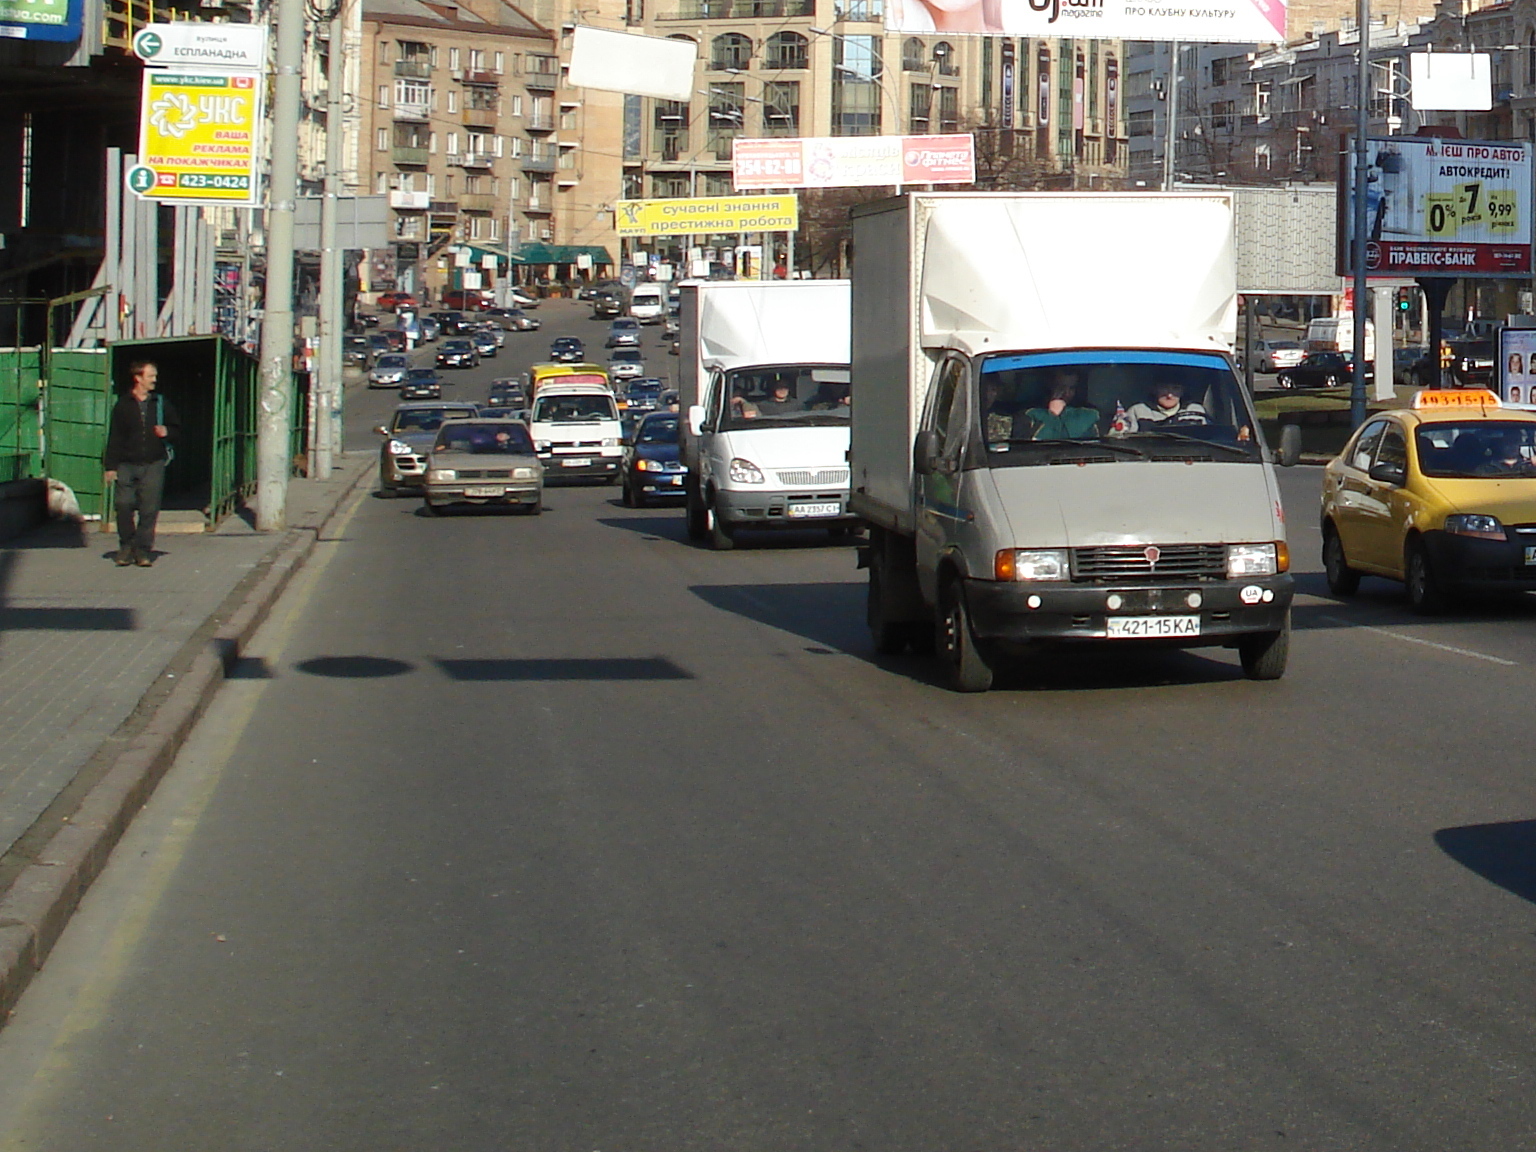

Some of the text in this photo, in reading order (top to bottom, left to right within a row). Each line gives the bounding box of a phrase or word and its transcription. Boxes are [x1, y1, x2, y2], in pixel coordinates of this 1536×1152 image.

[1125, 7, 1236, 19] ПРО КЛУБНУ КУЛЬТУРУ
[174, 47, 248, 59] ЕСПЛАНАДНА
[198, 95, 246, 124] УКС
[215, 131, 249, 139] ВАША
[193, 144, 250, 154] РЕКЛАМА
[1467, 147, 1489, 159] ПРО
[148, 156, 249, 167] НА ПОКАЖЧИКАХ
[1439, 166, 1510, 179] АВТОКРЕДИТ!
[181, 175, 248, 188] 423-0424
[1464, 184, 1480, 214] 7
[662, 201, 780, 216] сучасні знання
[651, 215, 793, 232] престижна робота
[1389, 252, 1476, 266] ПРАВЕКС-БАНК
[1245, 589, 1258, 597] UA
